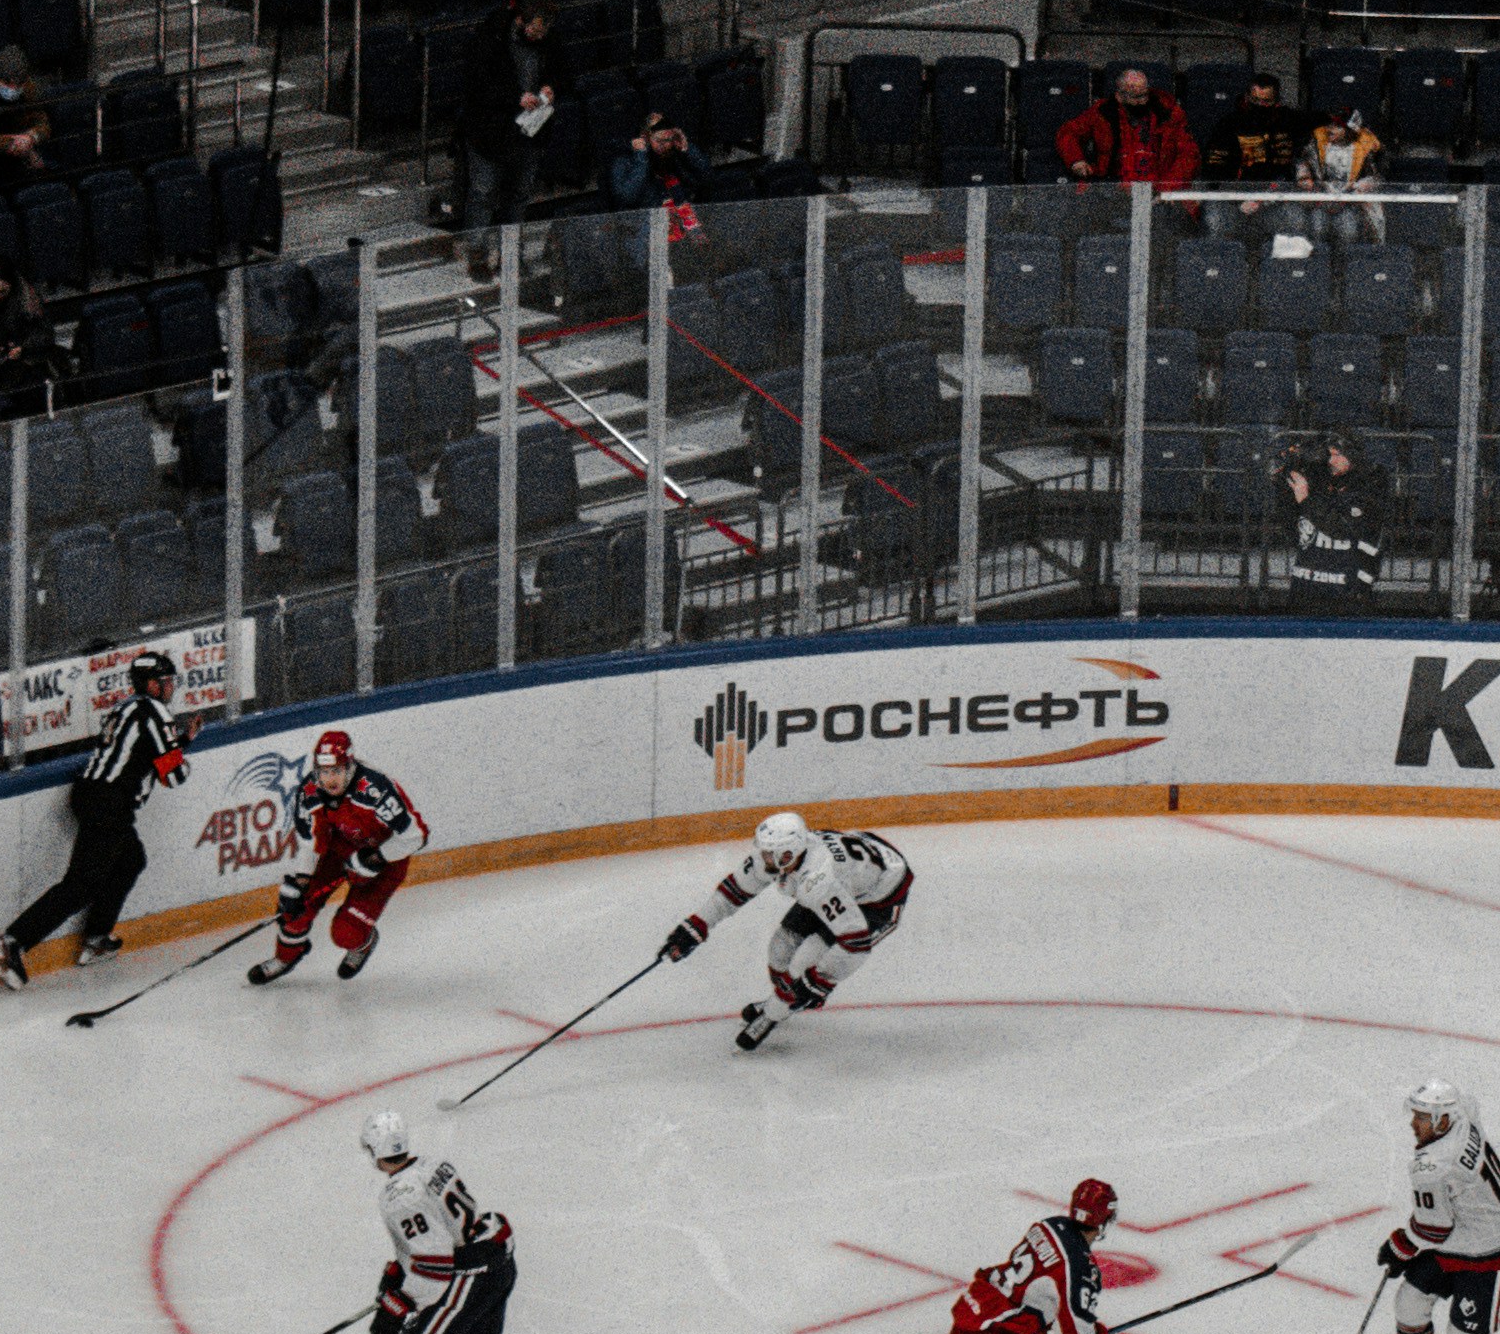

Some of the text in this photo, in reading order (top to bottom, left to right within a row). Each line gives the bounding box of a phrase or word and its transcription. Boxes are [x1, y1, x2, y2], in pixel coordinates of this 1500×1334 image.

[775, 689, 1171, 749] РОСНЕФТЬ
[195, 798, 277, 850] АВТО
[218, 828, 301, 876] РАДИ
[821, 896, 847, 923] 22
[1412, 1189, 1435, 1212] 10
[400, 1212, 430, 1241] 28
